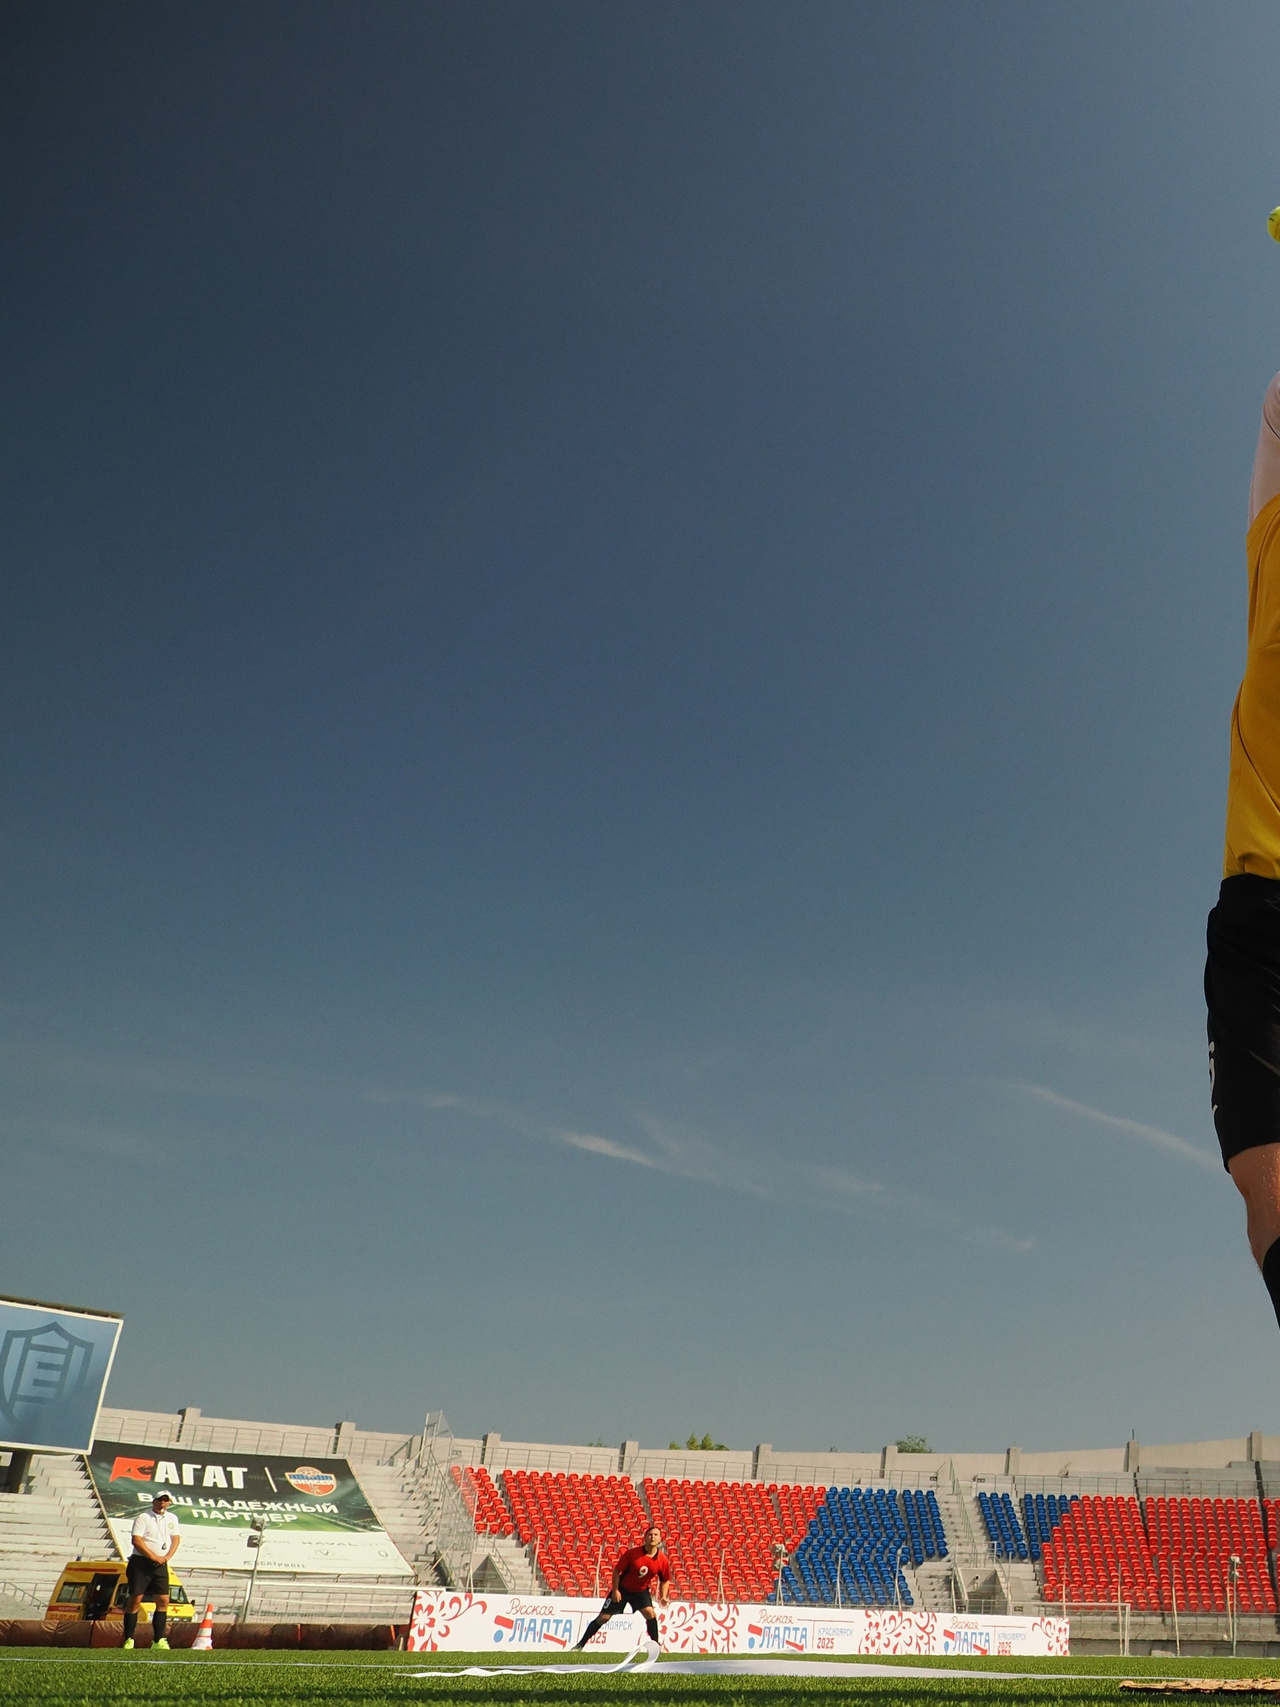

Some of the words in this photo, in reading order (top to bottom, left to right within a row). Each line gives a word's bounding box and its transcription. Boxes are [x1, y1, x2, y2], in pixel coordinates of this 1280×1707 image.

[154, 1460, 248, 1489] АГАТ
[137, 1492, 193, 1506] ВШ
[638, 1565, 649, 1579] 9
[508, 1617, 573, 1644] ЛАПТА
[587, 1631, 608, 1644] 025
[816, 1637, 835, 1649] 2025
